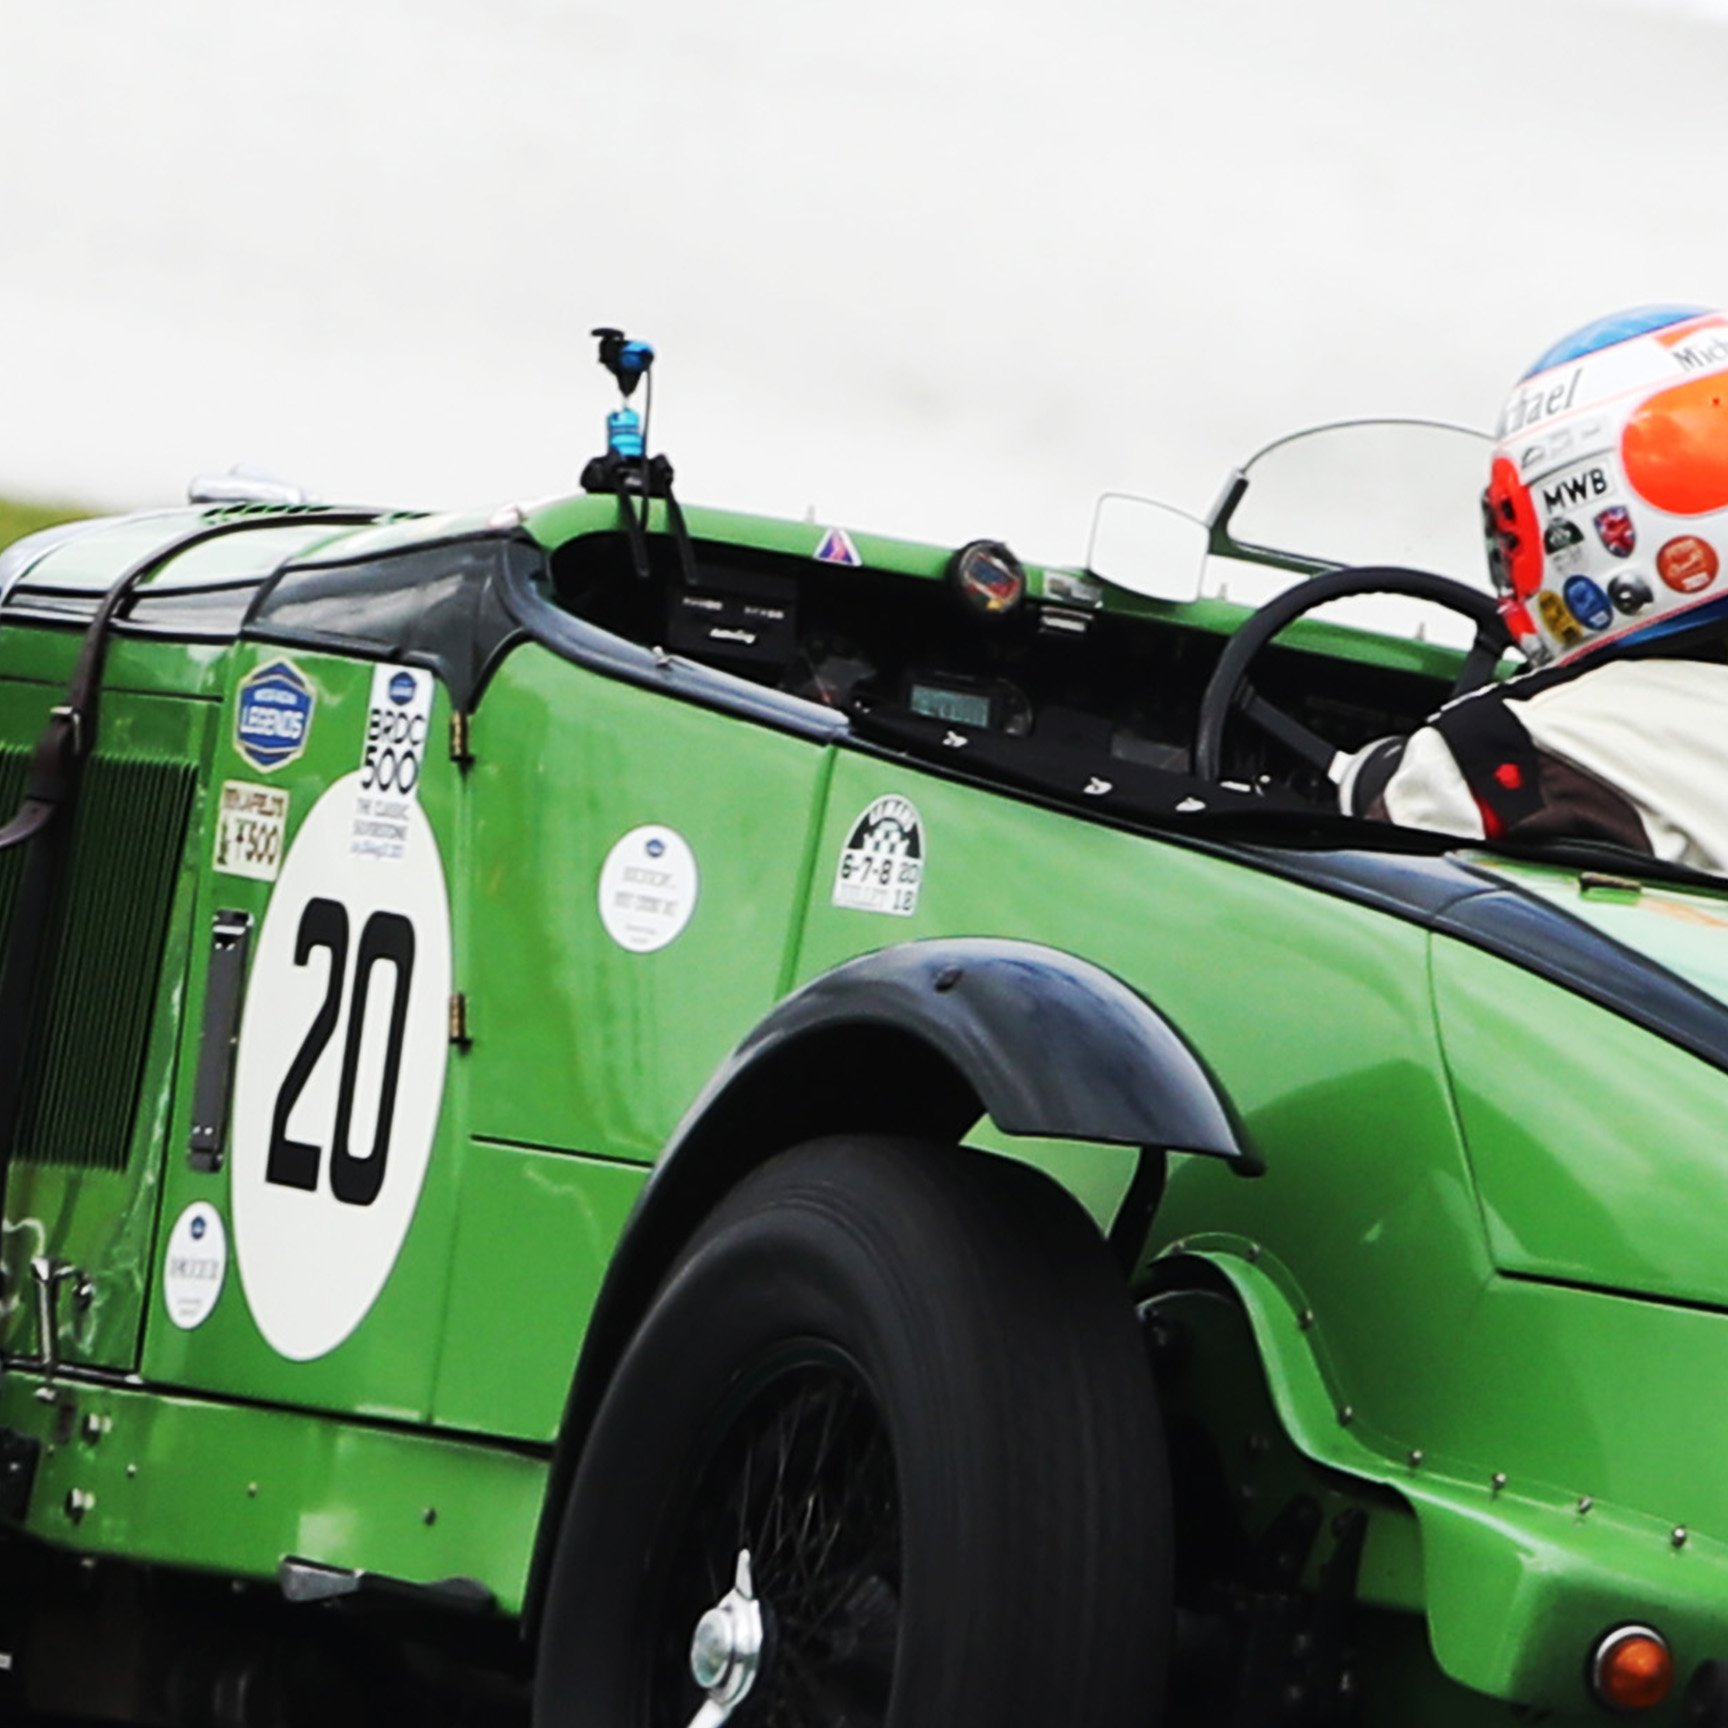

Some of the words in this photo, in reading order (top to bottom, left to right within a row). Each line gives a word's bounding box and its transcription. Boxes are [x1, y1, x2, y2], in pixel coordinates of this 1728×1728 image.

[1542, 467, 1609, 513] MWB
[239, 705, 305, 740] LEGENDS
[368, 708, 427, 747] BRDC
[361, 746, 419, 795] 500
[841, 853, 893, 885] 6-7-8
[897, 862, 920, 884] 20
[264, 896, 417, 1208] 20
